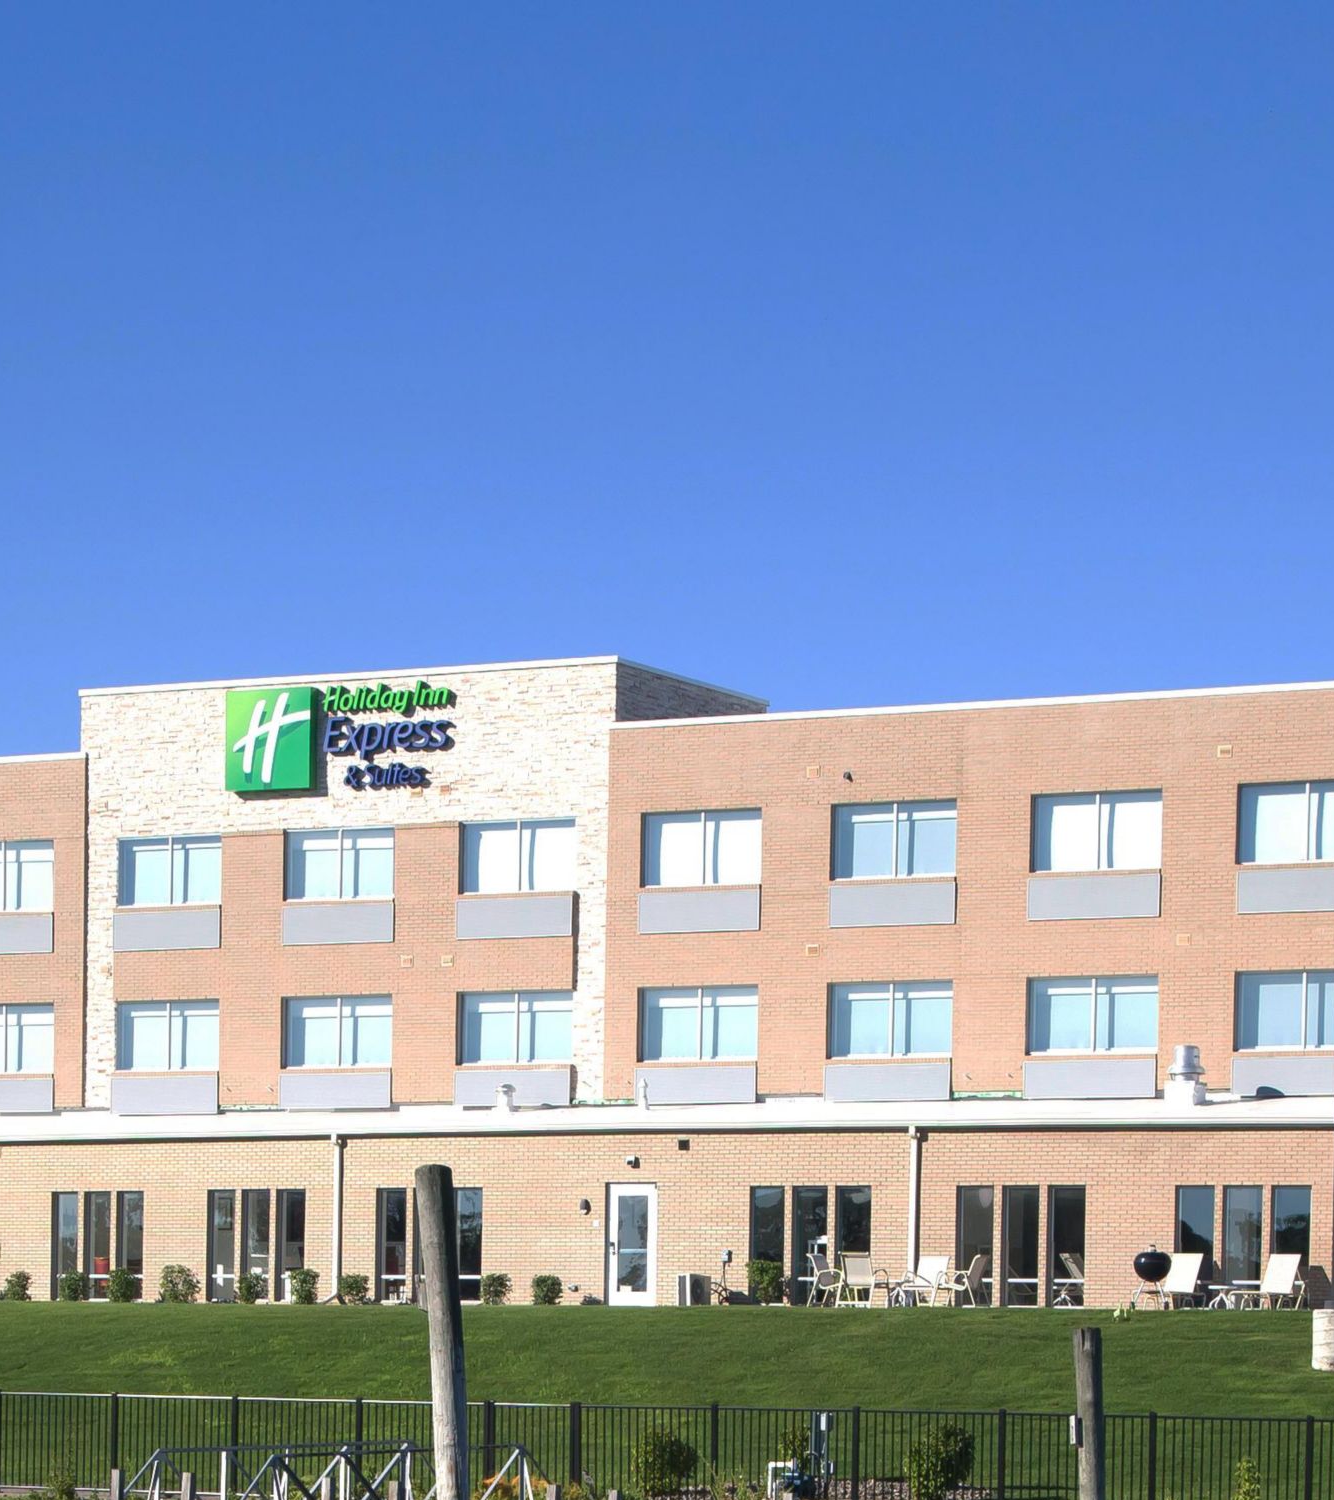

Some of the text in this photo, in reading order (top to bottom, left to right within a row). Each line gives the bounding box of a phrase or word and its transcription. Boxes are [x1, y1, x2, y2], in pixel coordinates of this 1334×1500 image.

[323, 680, 448, 713] Holiday Inn
[323, 716, 448, 760] Express
[344, 762, 422, 787] & Suites
